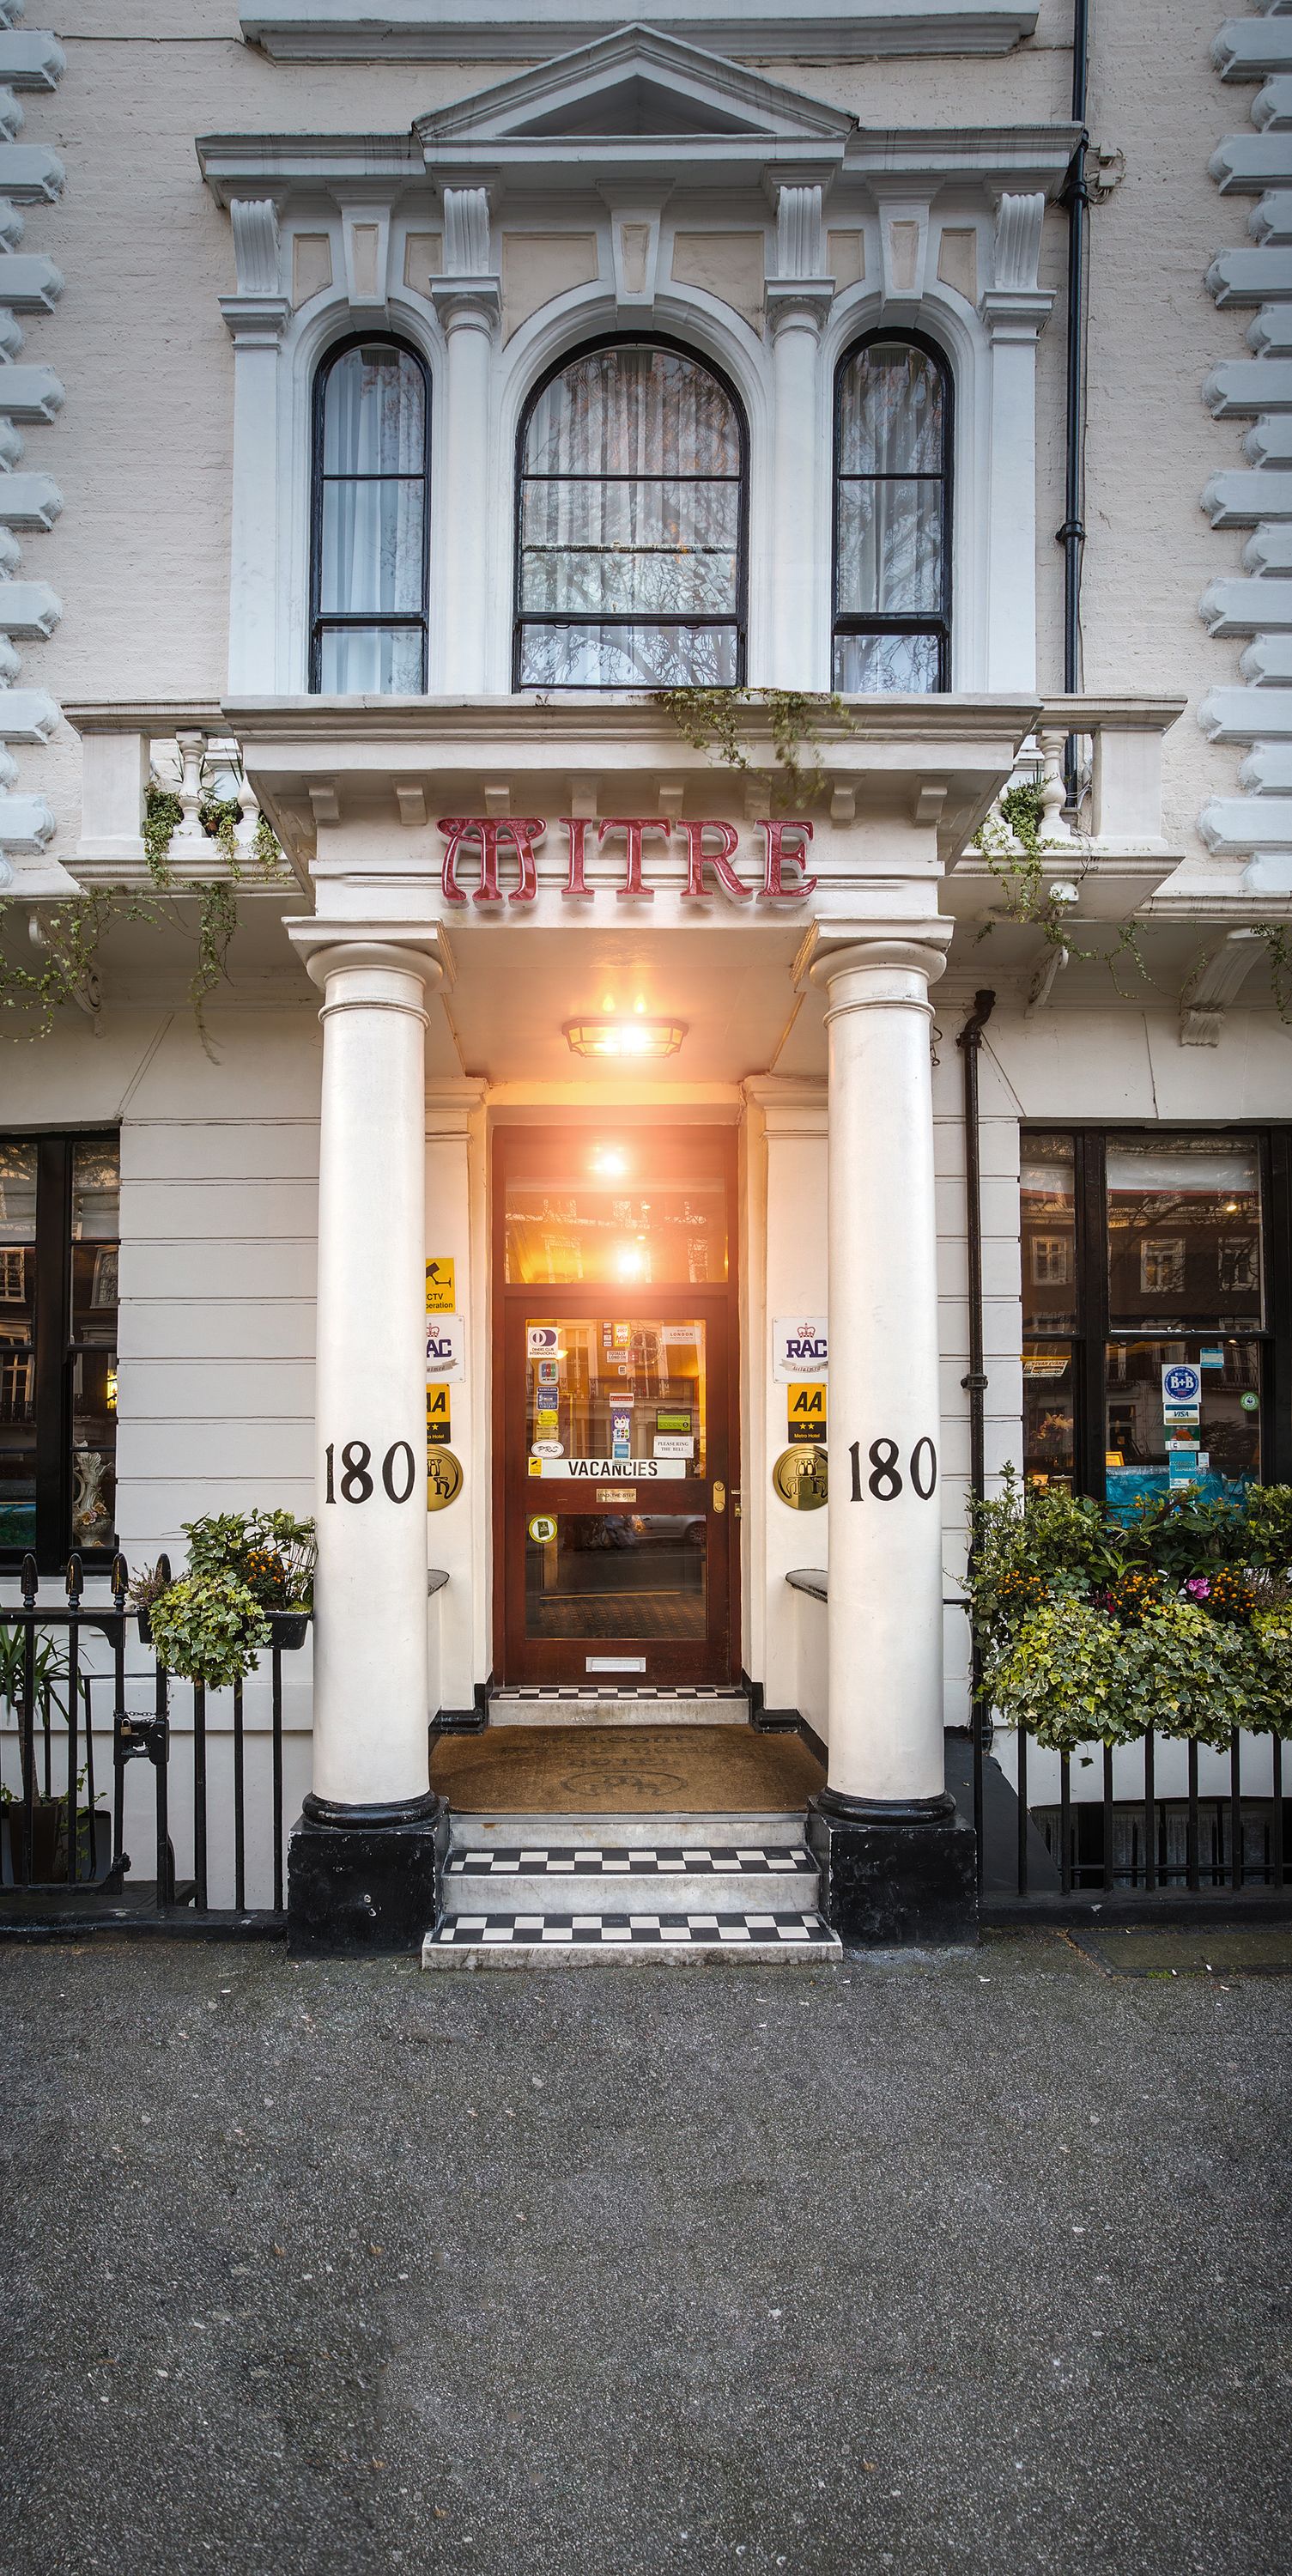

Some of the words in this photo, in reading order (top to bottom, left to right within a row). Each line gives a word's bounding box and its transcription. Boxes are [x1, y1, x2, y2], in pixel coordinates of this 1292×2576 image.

[435, 817, 818, 907] MITRE
[427, 1340, 452, 1358] AC
[786, 1340, 828, 1358] RAC
[793, 1391, 822, 1413] AA
[325, 1440, 416, 1505] 180
[567, 1461, 658, 1477] VACANCIES
[848, 1436, 937, 1503] 180
